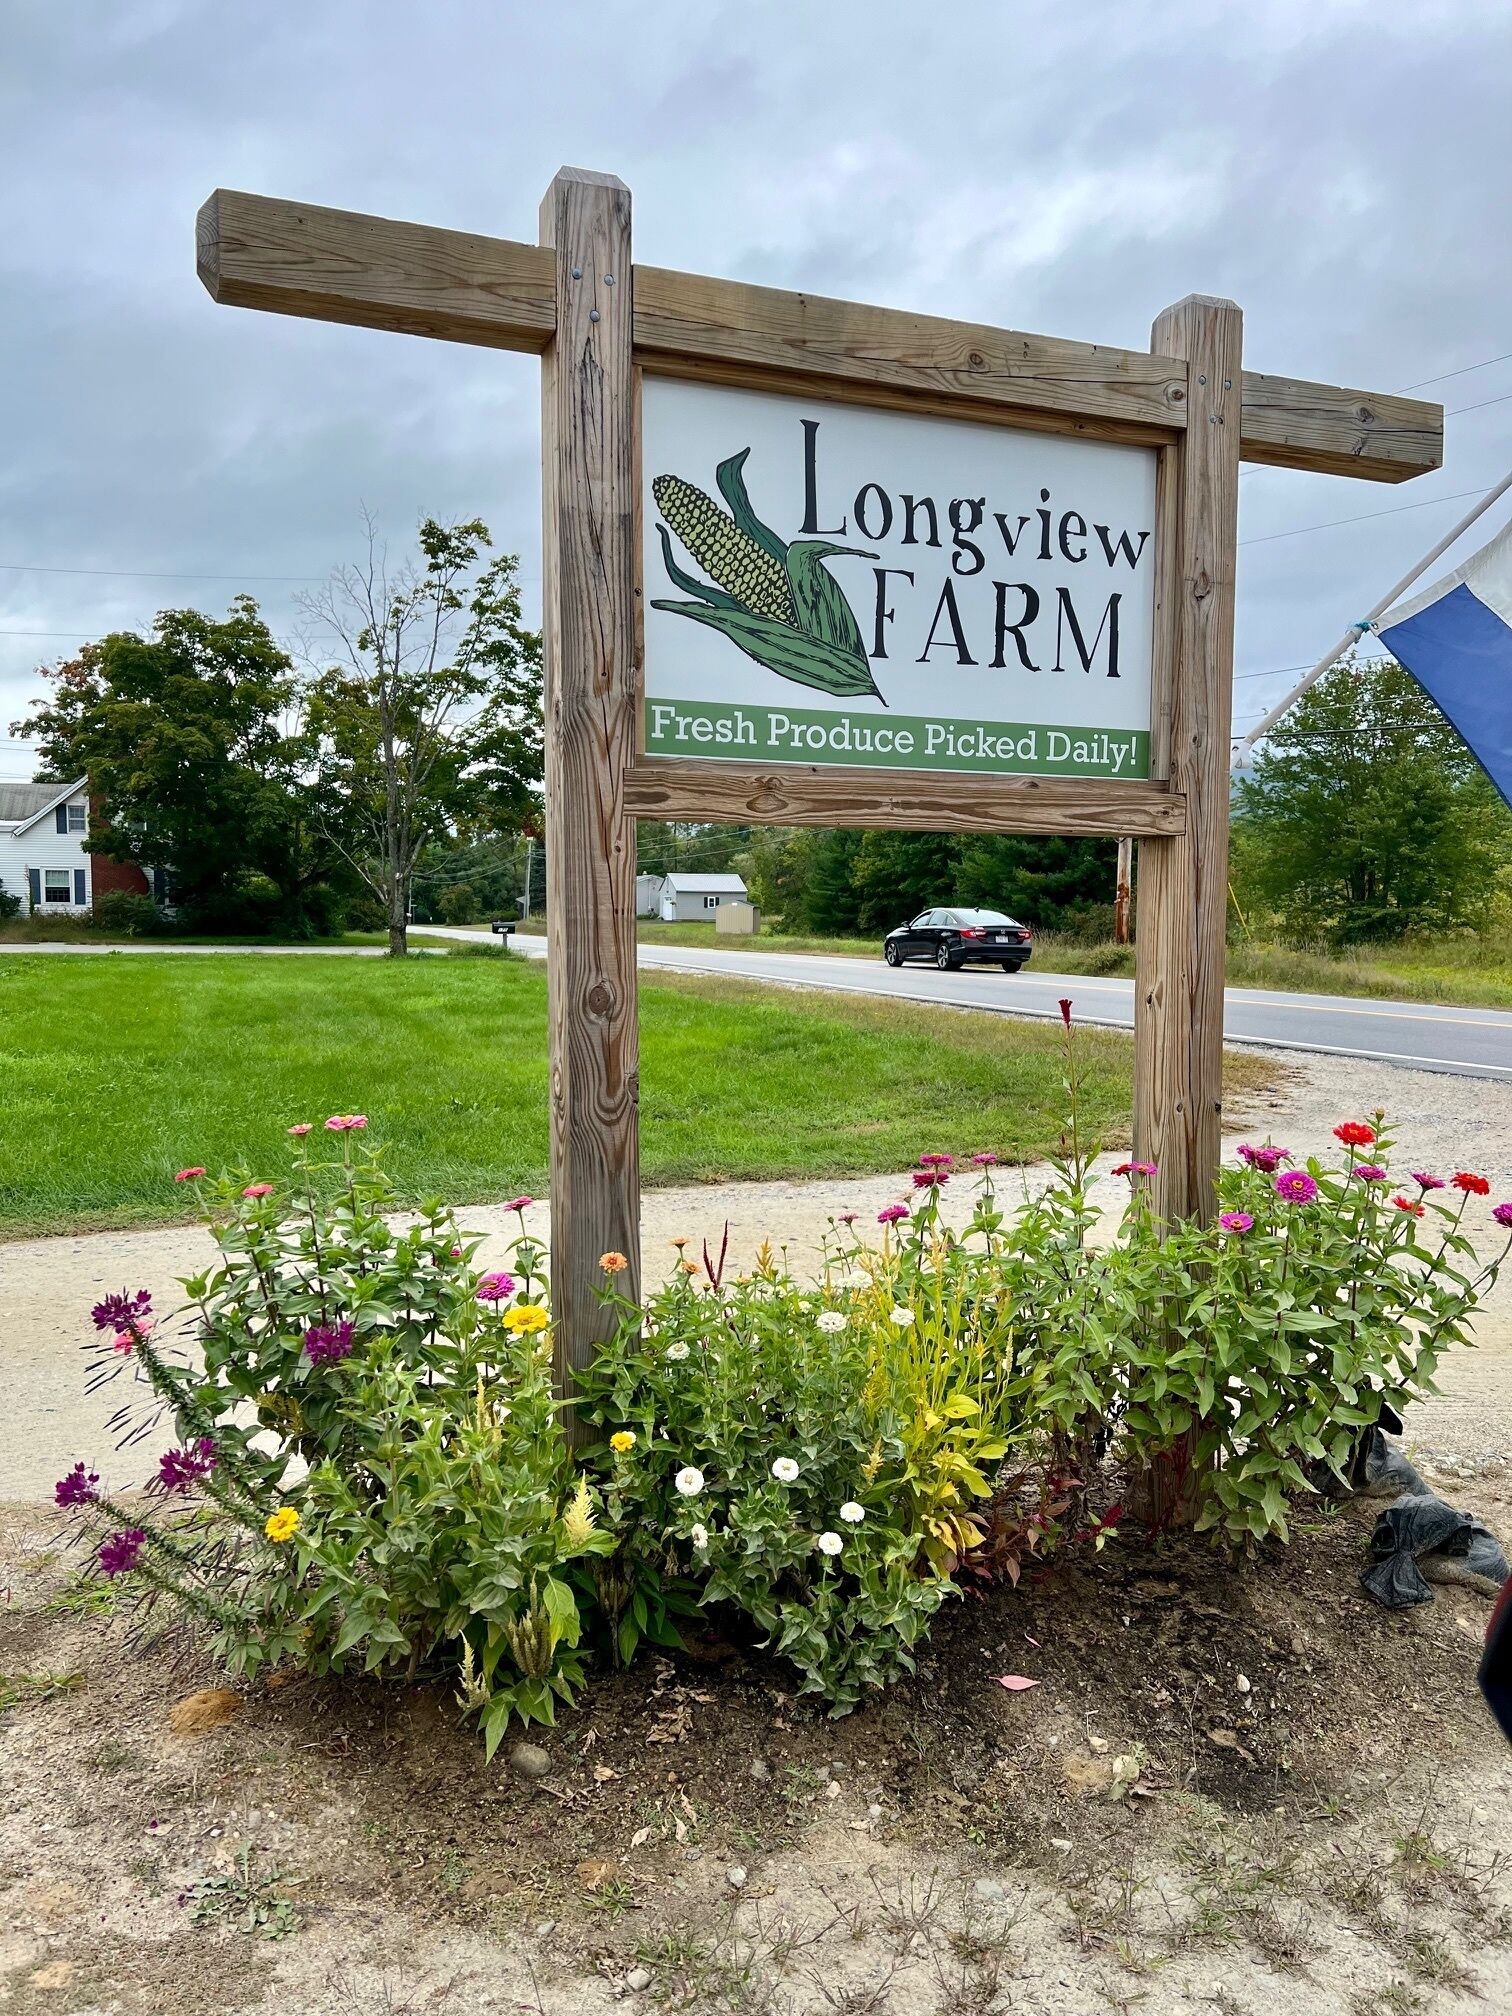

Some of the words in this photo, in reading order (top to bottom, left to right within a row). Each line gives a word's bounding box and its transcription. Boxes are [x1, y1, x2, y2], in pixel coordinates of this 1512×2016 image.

[798, 419, 1151, 576] Longview
[868, 567, 1122, 678] FARM
[650, 705, 757, 744] Fresh
[767, 712, 914, 754] Produce
[925, 723, 1037, 761] Picked
[1046, 729, 1137, 773] Daily!
